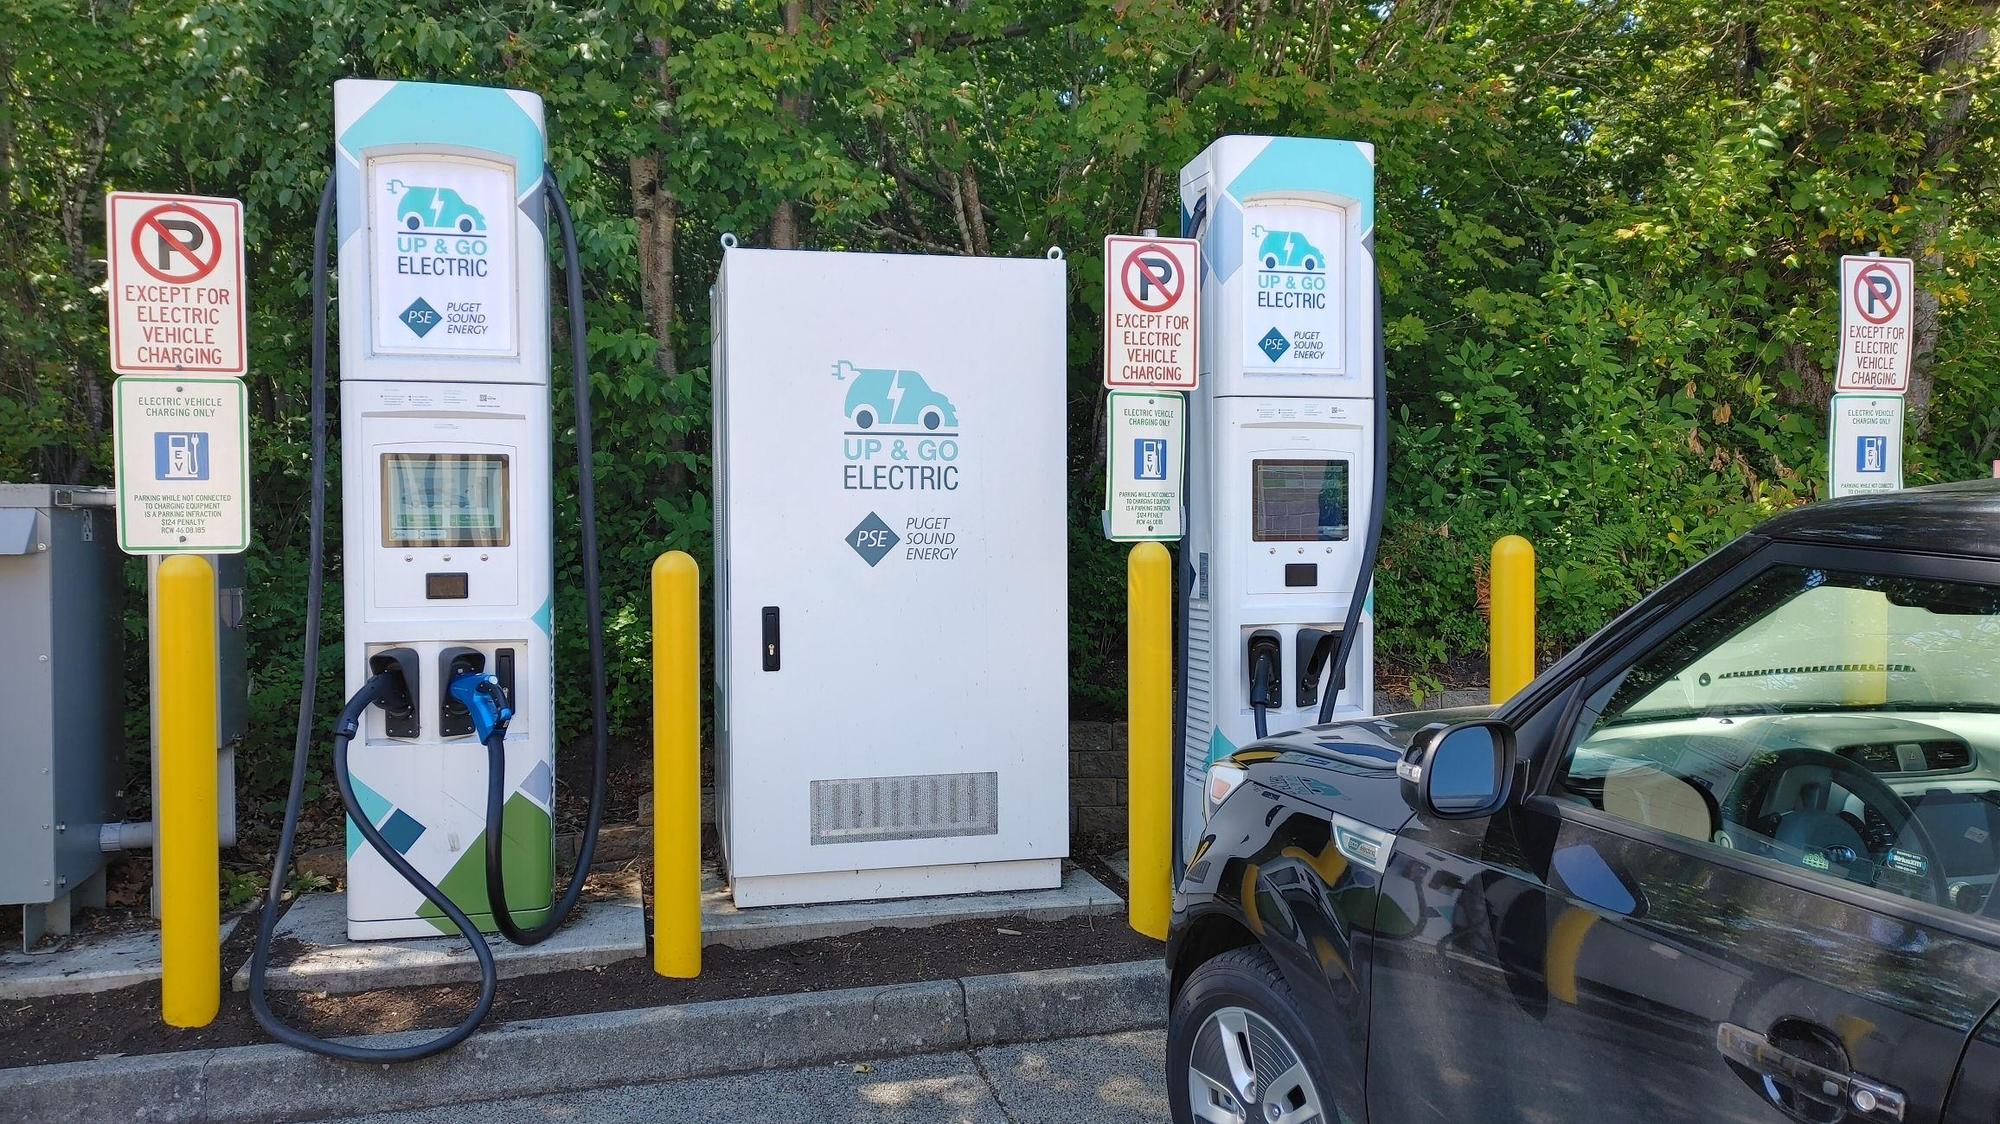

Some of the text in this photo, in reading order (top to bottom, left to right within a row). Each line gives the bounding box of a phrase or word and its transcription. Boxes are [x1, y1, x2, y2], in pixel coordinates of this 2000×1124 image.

[398, 237, 488, 256] UP & GO
[398, 256, 488, 277] ELECTRIC
[1258, 275, 1326, 291] UP & GO
[125, 285, 230, 305] EXCEPT FOR
[1258, 291, 1326, 309] ELECTRIC
[446, 302, 482, 313] PUGET
[136, 306, 220, 325] ELECTRIC
[408, 310, 433, 324] PSE
[447, 313, 486, 324] SOUND
[1116, 314, 1189, 330] EXCEPT FOR
[142, 326, 215, 344] VEHICLE
[447, 324, 488, 335] ENERGY
[1294, 331, 1320, 340] PUGET
[1849, 325, 1904, 340] EXCEPT FOR
[1123, 331, 1182, 347] ELECTRIC
[1264, 338, 1284, 350] PSE
[1294, 341, 1324, 350] SOUND
[1855, 341, 1899, 355] ELECTRIC
[137, 346, 222, 364] CHARGING
[1127, 348, 1177, 364] VEHICLE
[1294, 351, 1325, 360] ENERGY
[1857, 356, 1894, 370] VEHICLE
[1122, 365, 1182, 380] CHARGING
[1851, 371, 1897, 385] CHARGING
[138, 397, 222, 407] ELECTRIC VEHICLE
[146, 408, 216, 417] CHARGING ONLY
[1124, 408, 1174, 418] ELECTRIC VEHICLE
[1848, 409, 1894, 417] ELECTRIC VEHICLE
[1128, 418, 1170, 427] CHARGING ONLY
[1852, 417, 1878, 425] CHARGING
[843, 438, 959, 462] UP & GO
[843, 465, 959, 491] ELECTRIC
[134, 494, 231, 502] PARKING WHILE NOT CONNECTED
[145, 502, 220, 510] TO CHARGING EQUIPMENT
[144, 510, 222, 518] IS A PARKING INFRACTION
[161, 518, 205, 526] $124 PENALTY
[906, 517, 951, 530] PUGET
[161, 526, 174, 534] RCW
[856, 530, 888, 548] PSE
[906, 532, 956, 545] SOUND
[906, 547, 959, 560] ENERGY
